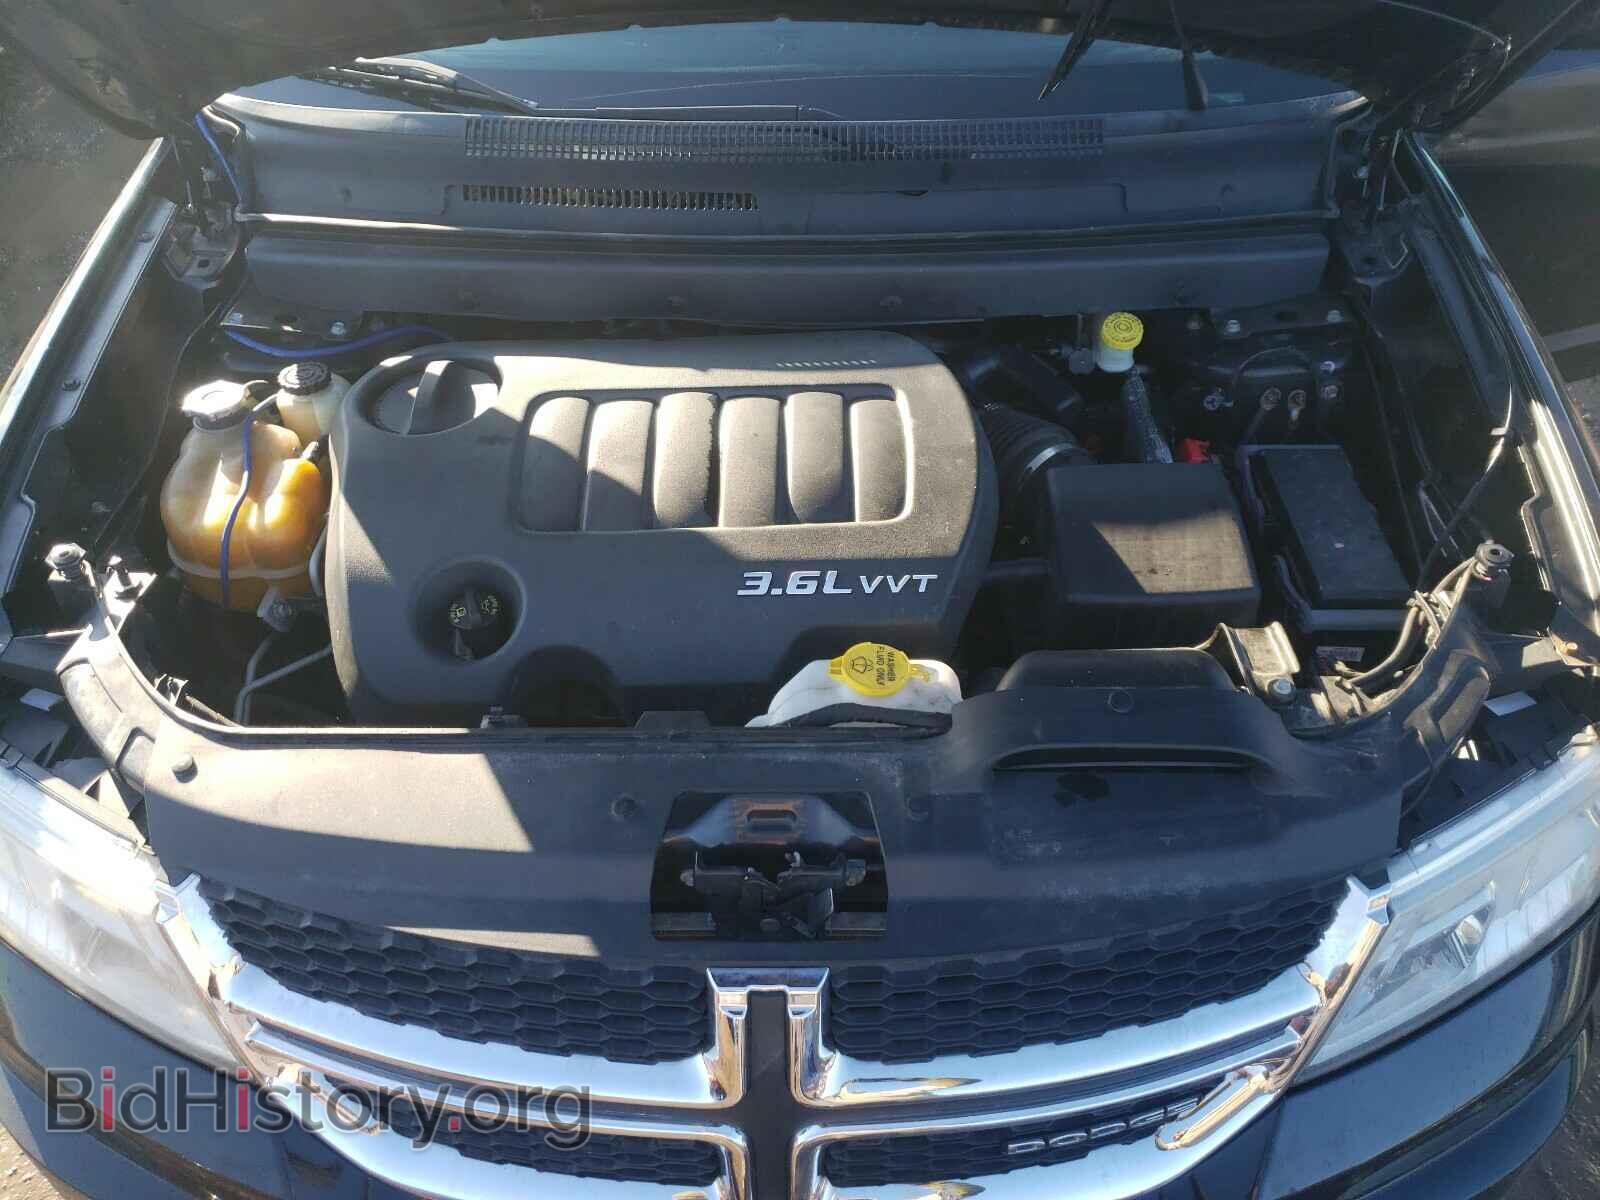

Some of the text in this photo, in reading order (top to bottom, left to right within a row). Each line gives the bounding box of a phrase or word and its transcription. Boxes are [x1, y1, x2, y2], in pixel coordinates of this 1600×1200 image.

[736, 570, 938, 596] 3.6L VVT
[876, 646, 885, 686] FLUID ONLY
[887, 650, 897, 681] WASHER
[1007, 1098, 1199, 1154] DODGE
